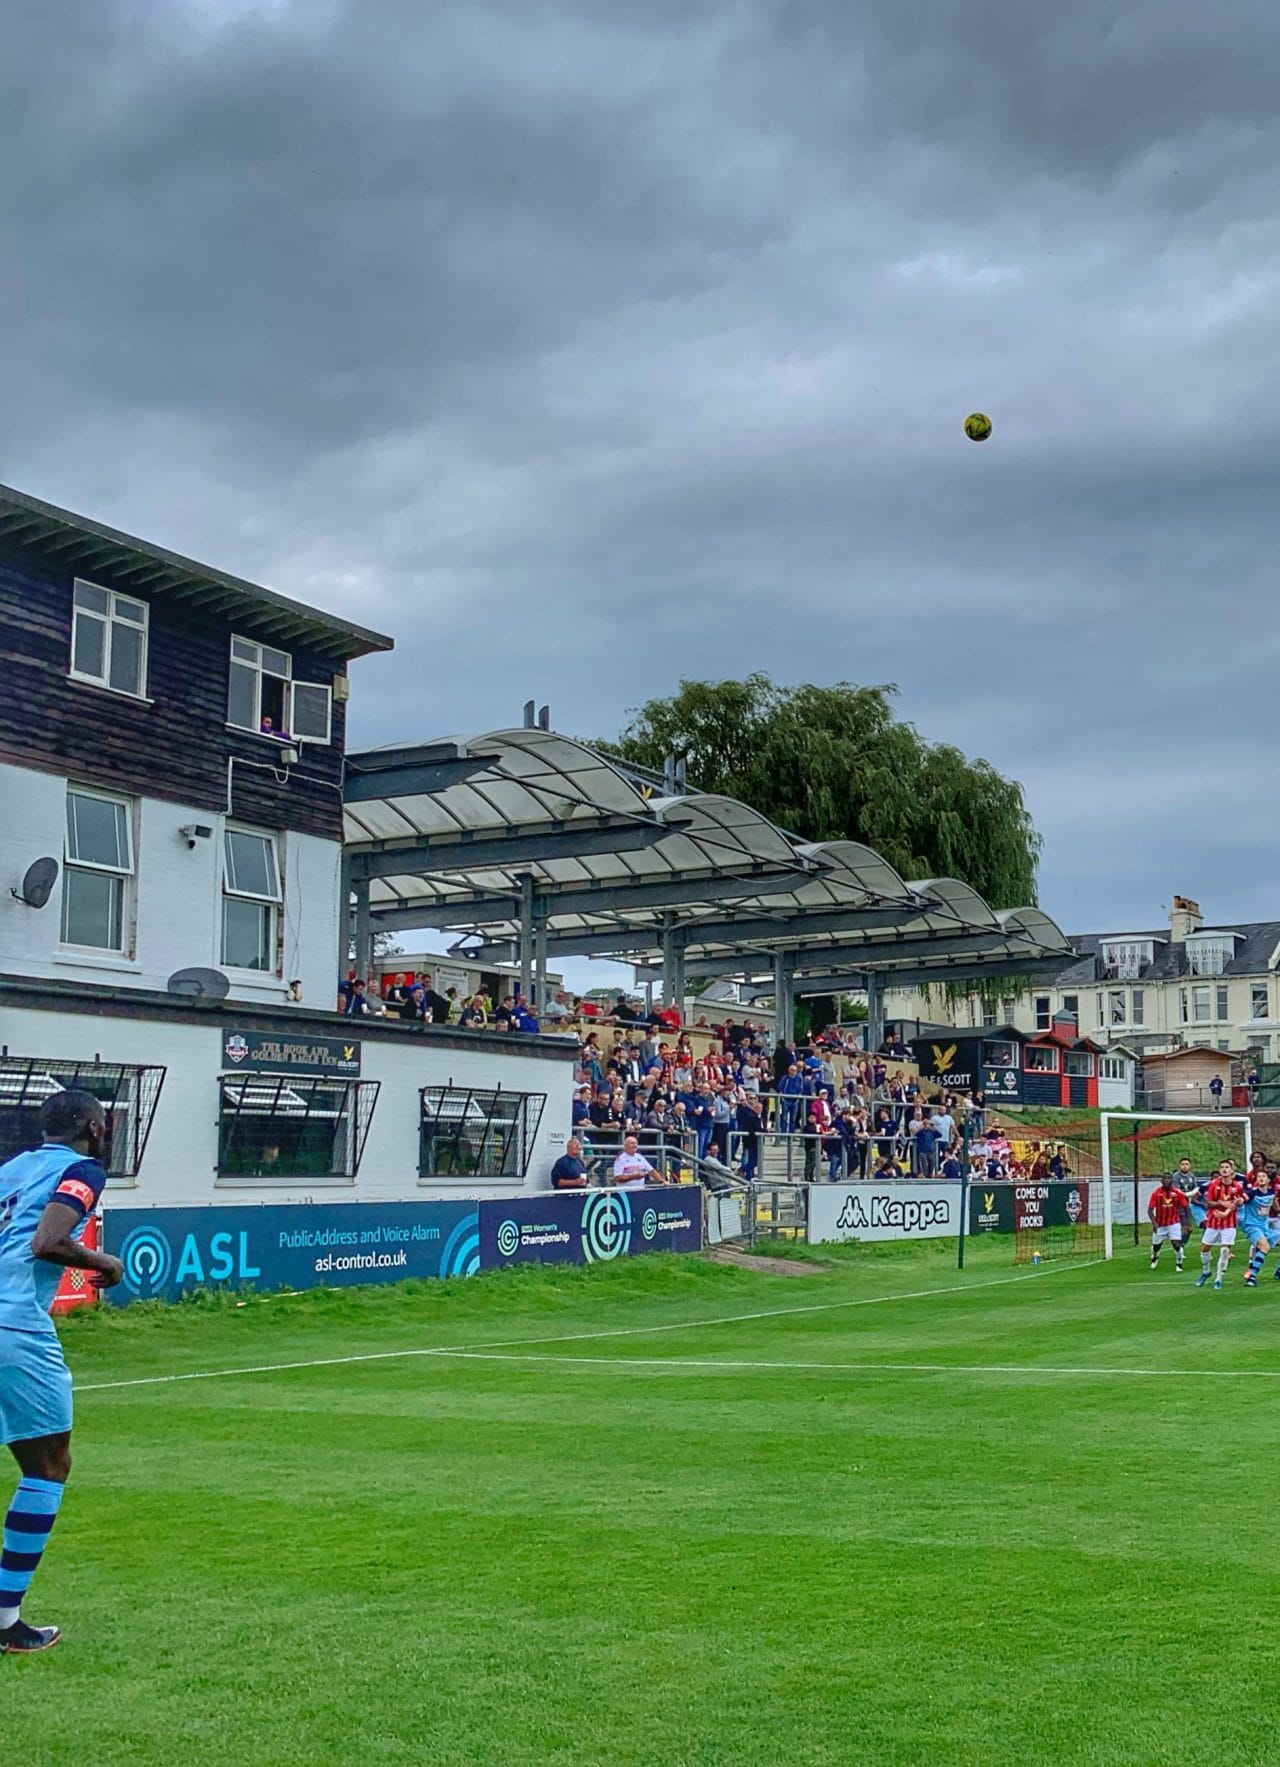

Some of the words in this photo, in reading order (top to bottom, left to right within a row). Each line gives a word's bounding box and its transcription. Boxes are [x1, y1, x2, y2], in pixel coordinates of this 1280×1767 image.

[943, 1074, 971, 1086] SCOTT
[1015, 1187, 1036, 1200] COME
[1037, 1187, 1049, 1199] ON
[871, 1196, 950, 1231] Kappa
[1024, 1201, 1040, 1213] YOU
[360, 1228, 381, 1244] and
[382, 1226, 409, 1242] Voice
[411, 1226, 440, 1241] Alarm
[521, 1231, 570, 1246] Championship
[175, 1231, 261, 1284] ASL
[315, 1249, 407, 1272] asl-control.co.uk
